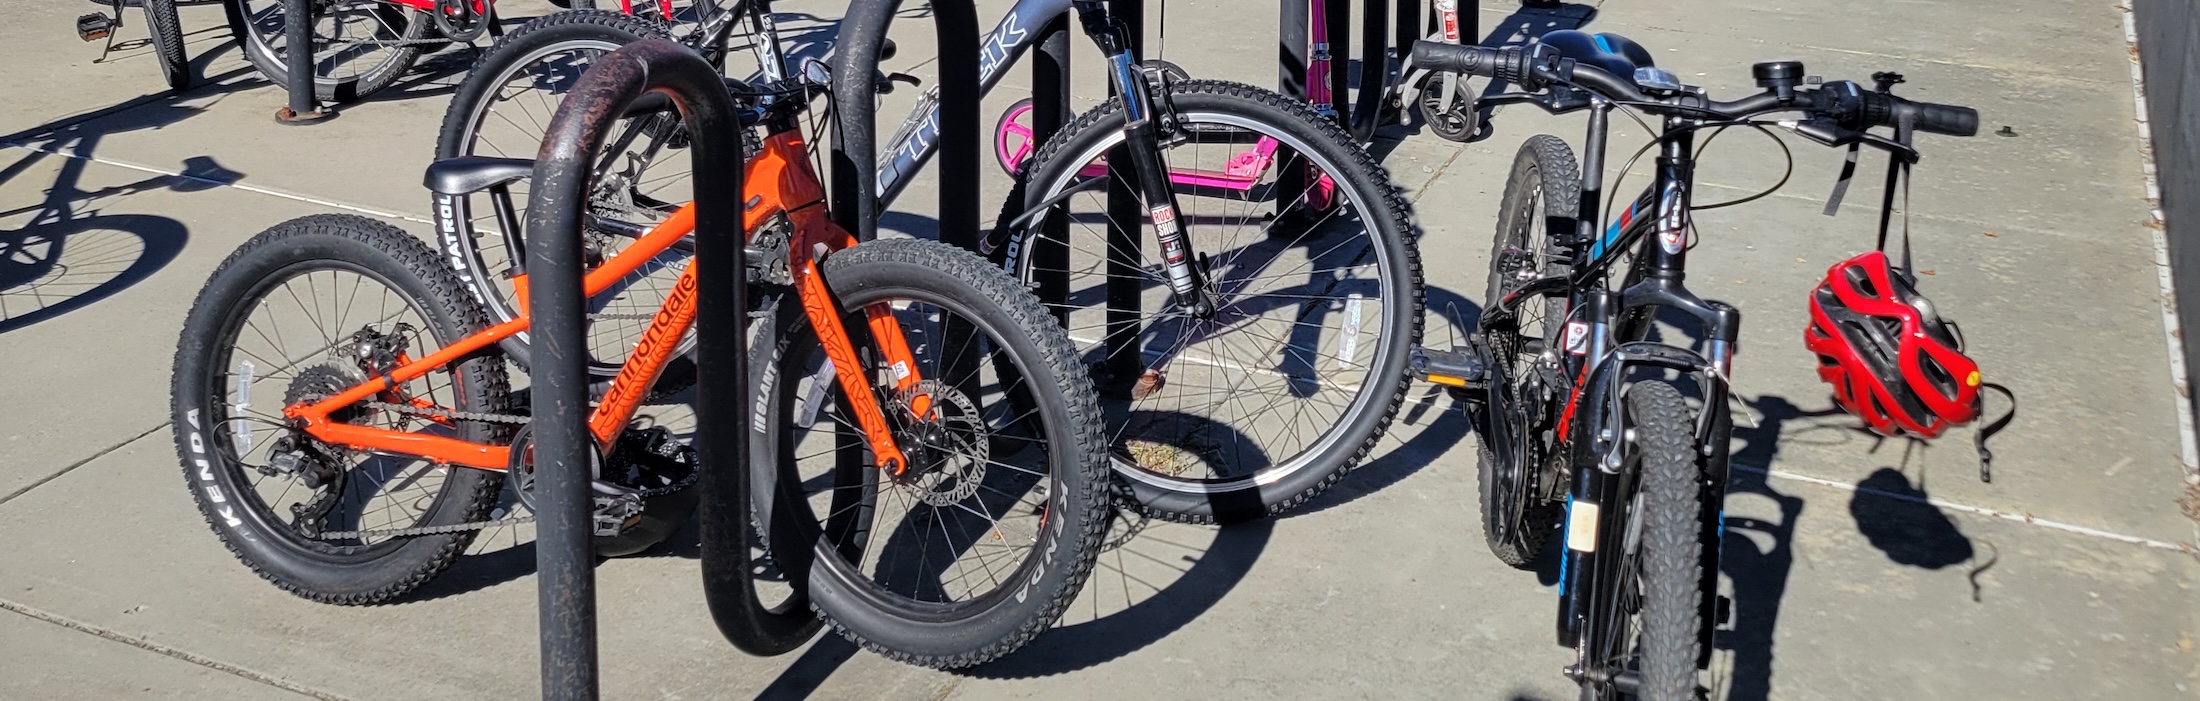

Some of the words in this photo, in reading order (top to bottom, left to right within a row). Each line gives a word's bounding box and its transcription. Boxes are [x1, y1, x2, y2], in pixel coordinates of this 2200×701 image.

[439, 195, 467, 271] PATROL
[1003, 229, 1025, 275] ROL
[1153, 208, 1174, 223] ROCK
[600, 273, 695, 417] cannondale
[755, 360, 778, 416] SLANT
[772, 332, 792, 362] SIX
[187, 407, 243, 528] KENDA
[1014, 480, 1070, 604] KENDA
